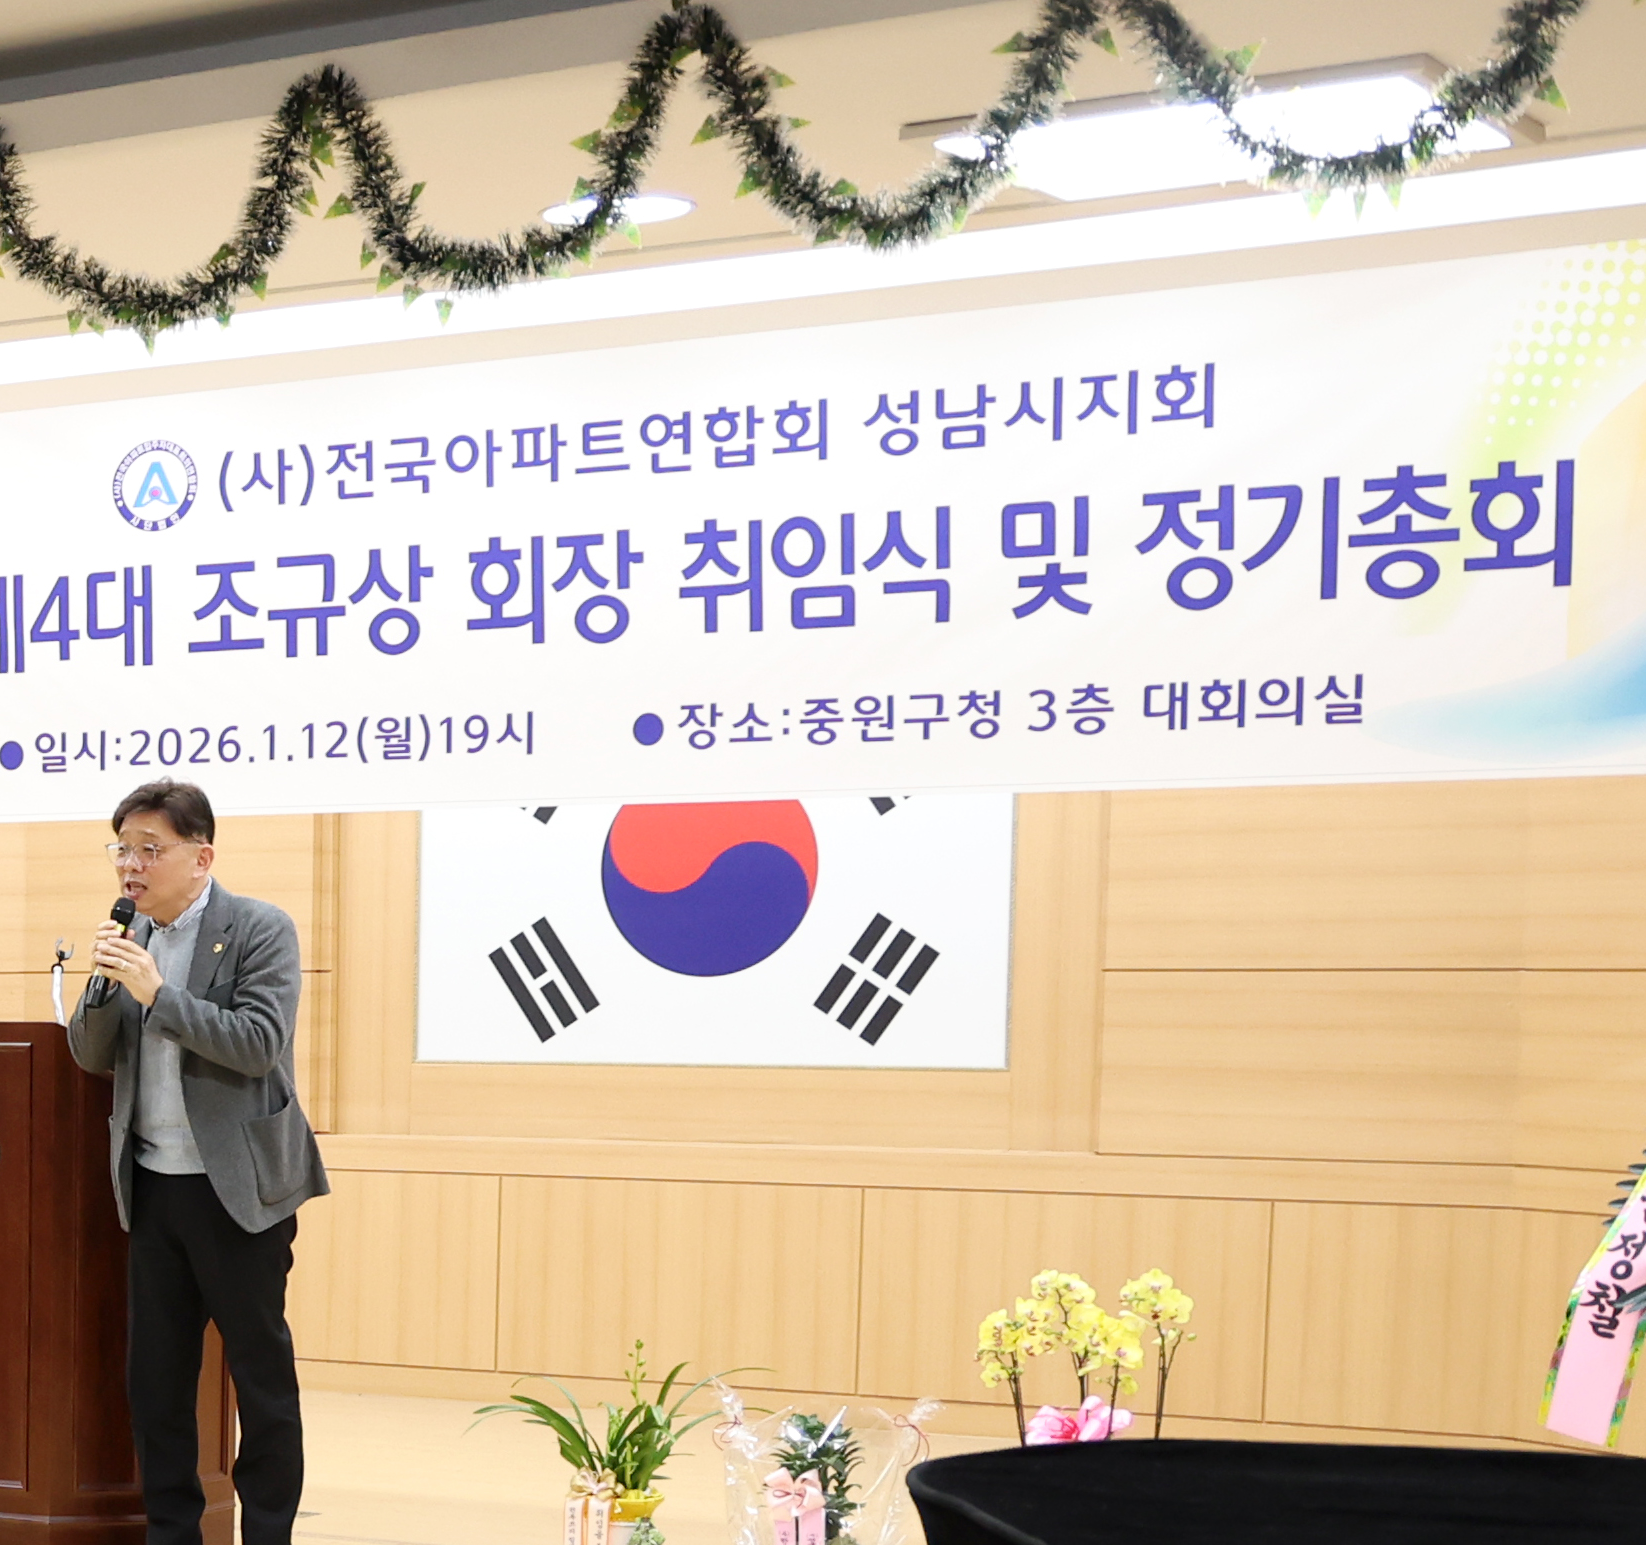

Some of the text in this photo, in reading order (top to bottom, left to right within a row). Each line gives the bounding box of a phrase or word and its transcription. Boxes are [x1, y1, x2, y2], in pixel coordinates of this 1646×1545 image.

[218, 398, 830, 512] (사)전국아파트연합회
[862, 361, 1217, 456] 성남시지회
[188, 545, 434, 659] 조규상
[466, 528, 645, 645] 회장
[678, 505, 952, 633] 취임식
[1000, 494, 1094, 620] 및
[1135, 458, 1577, 611] 정기총회
[34, 673, 1366, 774] 일시:2026.1.12(월)19시 장소:중원구청 3층 대회의실
[1579, 1194, 1646, 1340] 정철
